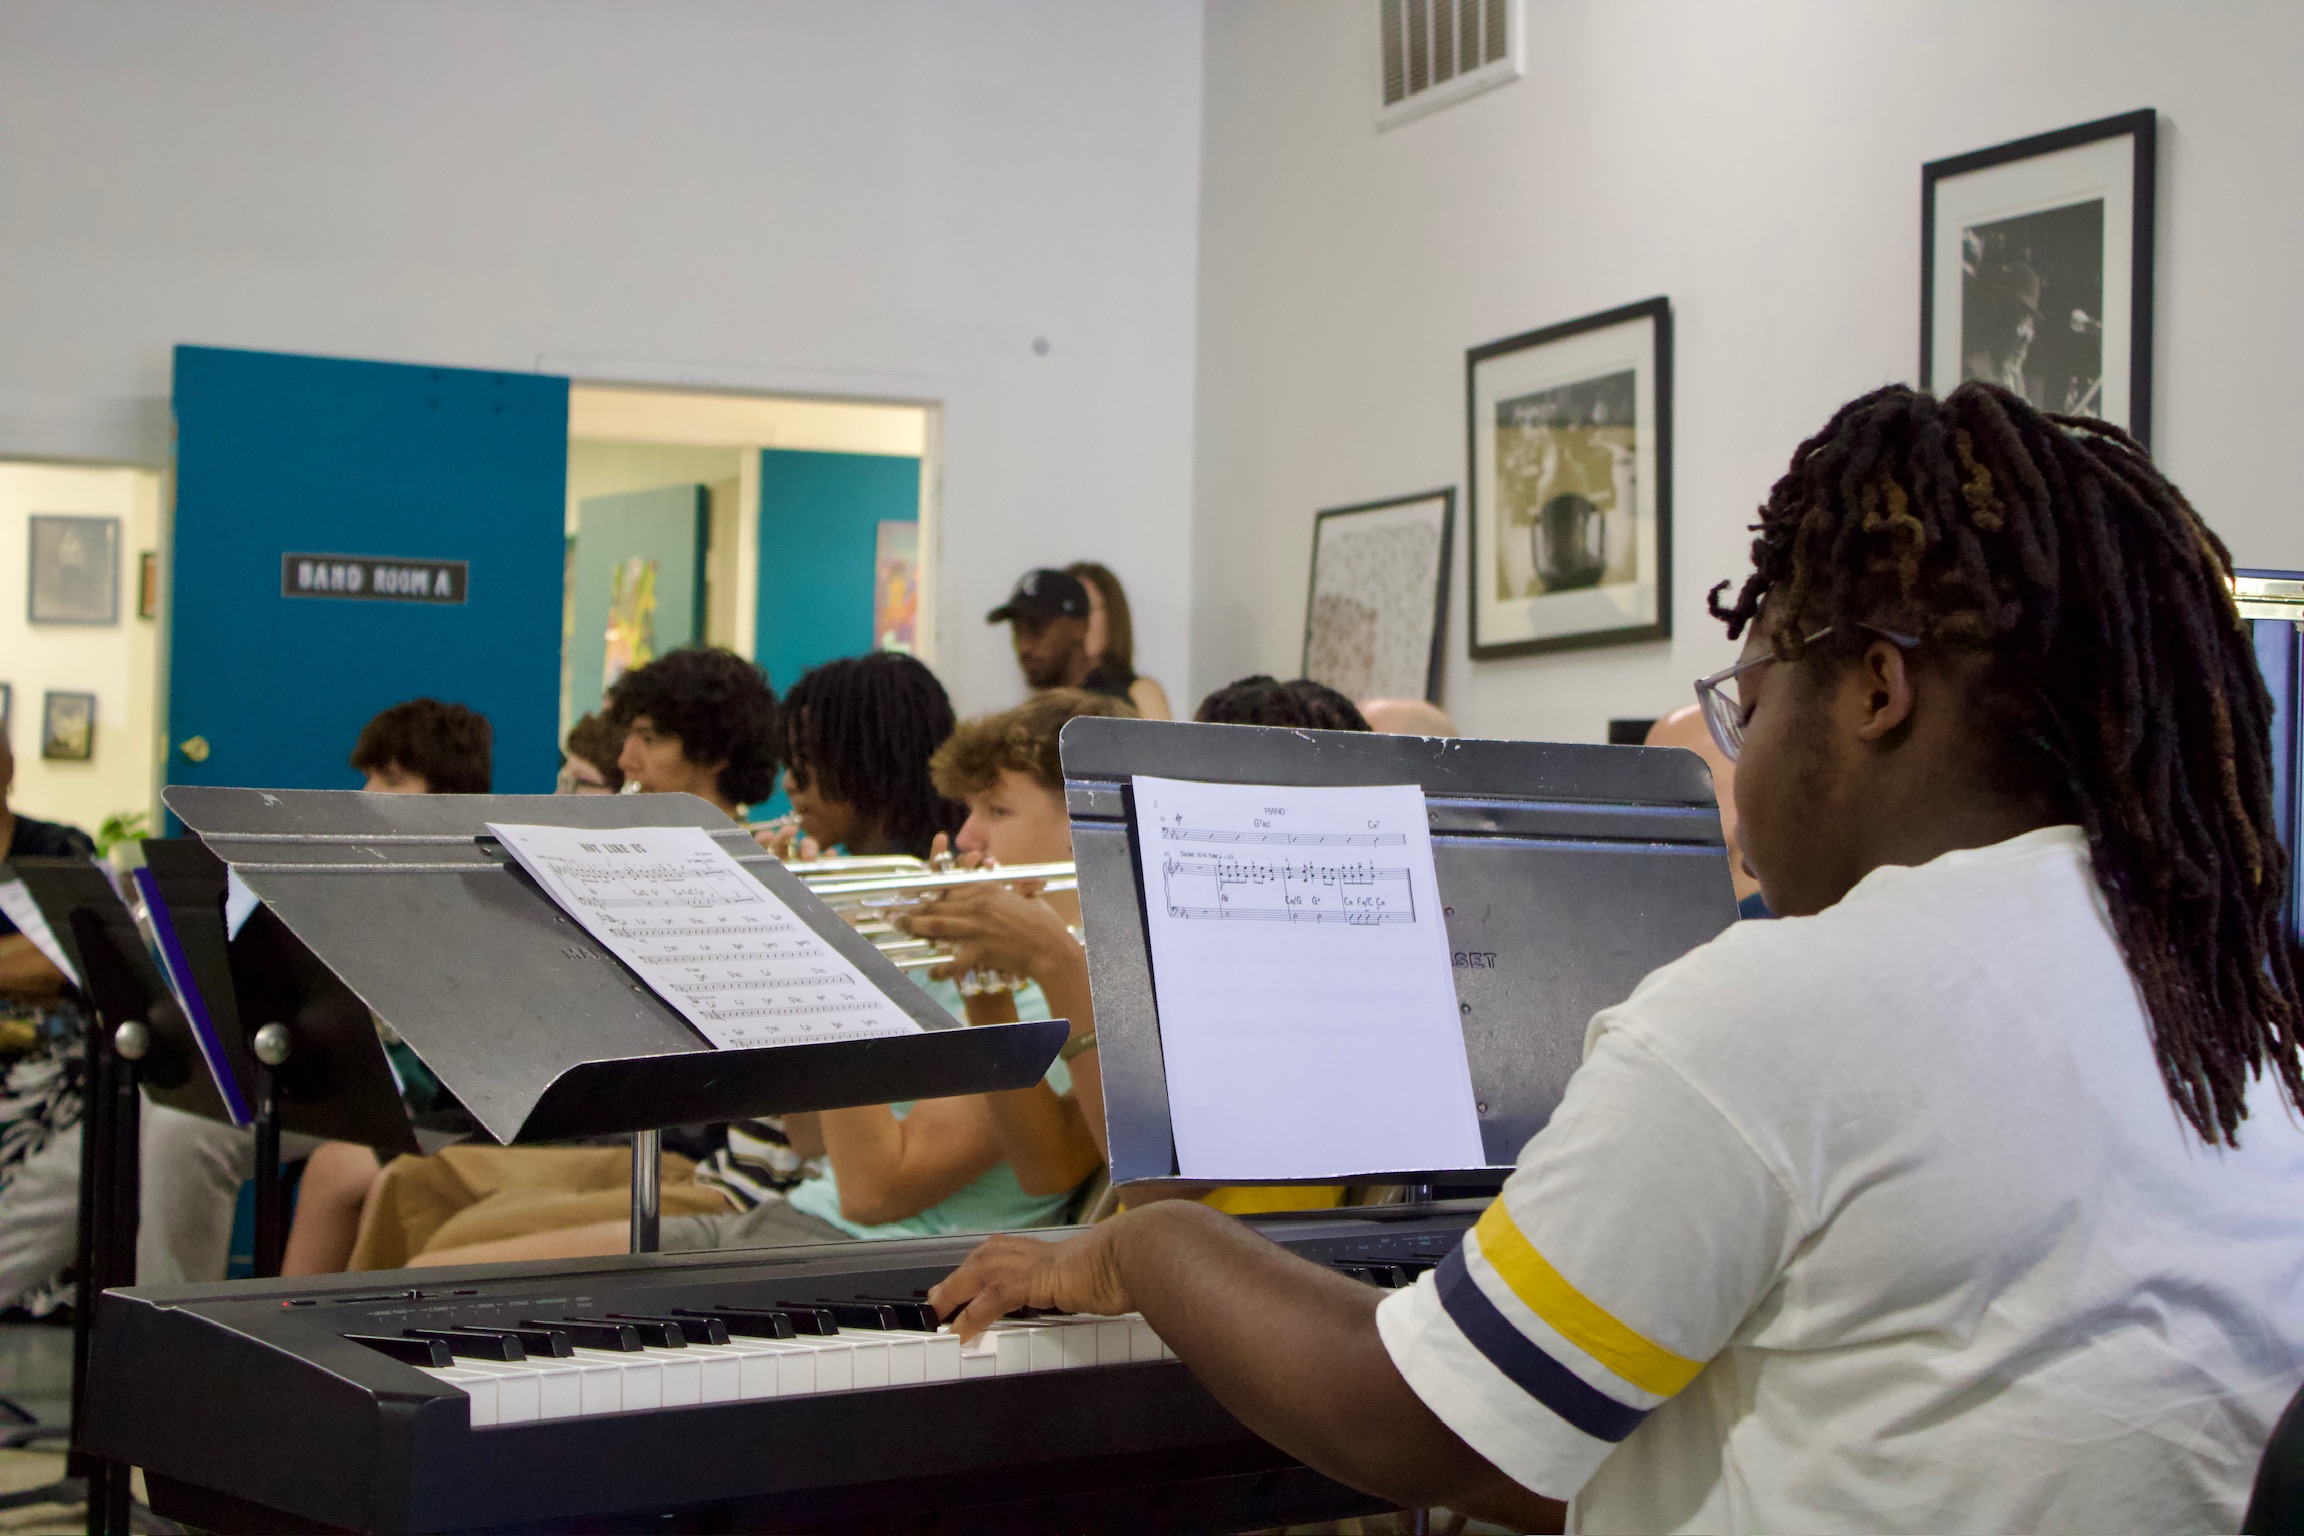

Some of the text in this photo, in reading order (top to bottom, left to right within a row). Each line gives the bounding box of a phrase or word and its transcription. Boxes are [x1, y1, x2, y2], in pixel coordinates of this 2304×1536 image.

[299, 561, 449, 597] BAND ROOM A
[1264, 807, 1286, 816] PIANO
[578, 842, 647, 854] NOT LIKE US
[1450, 952, 1497, 969] SET
